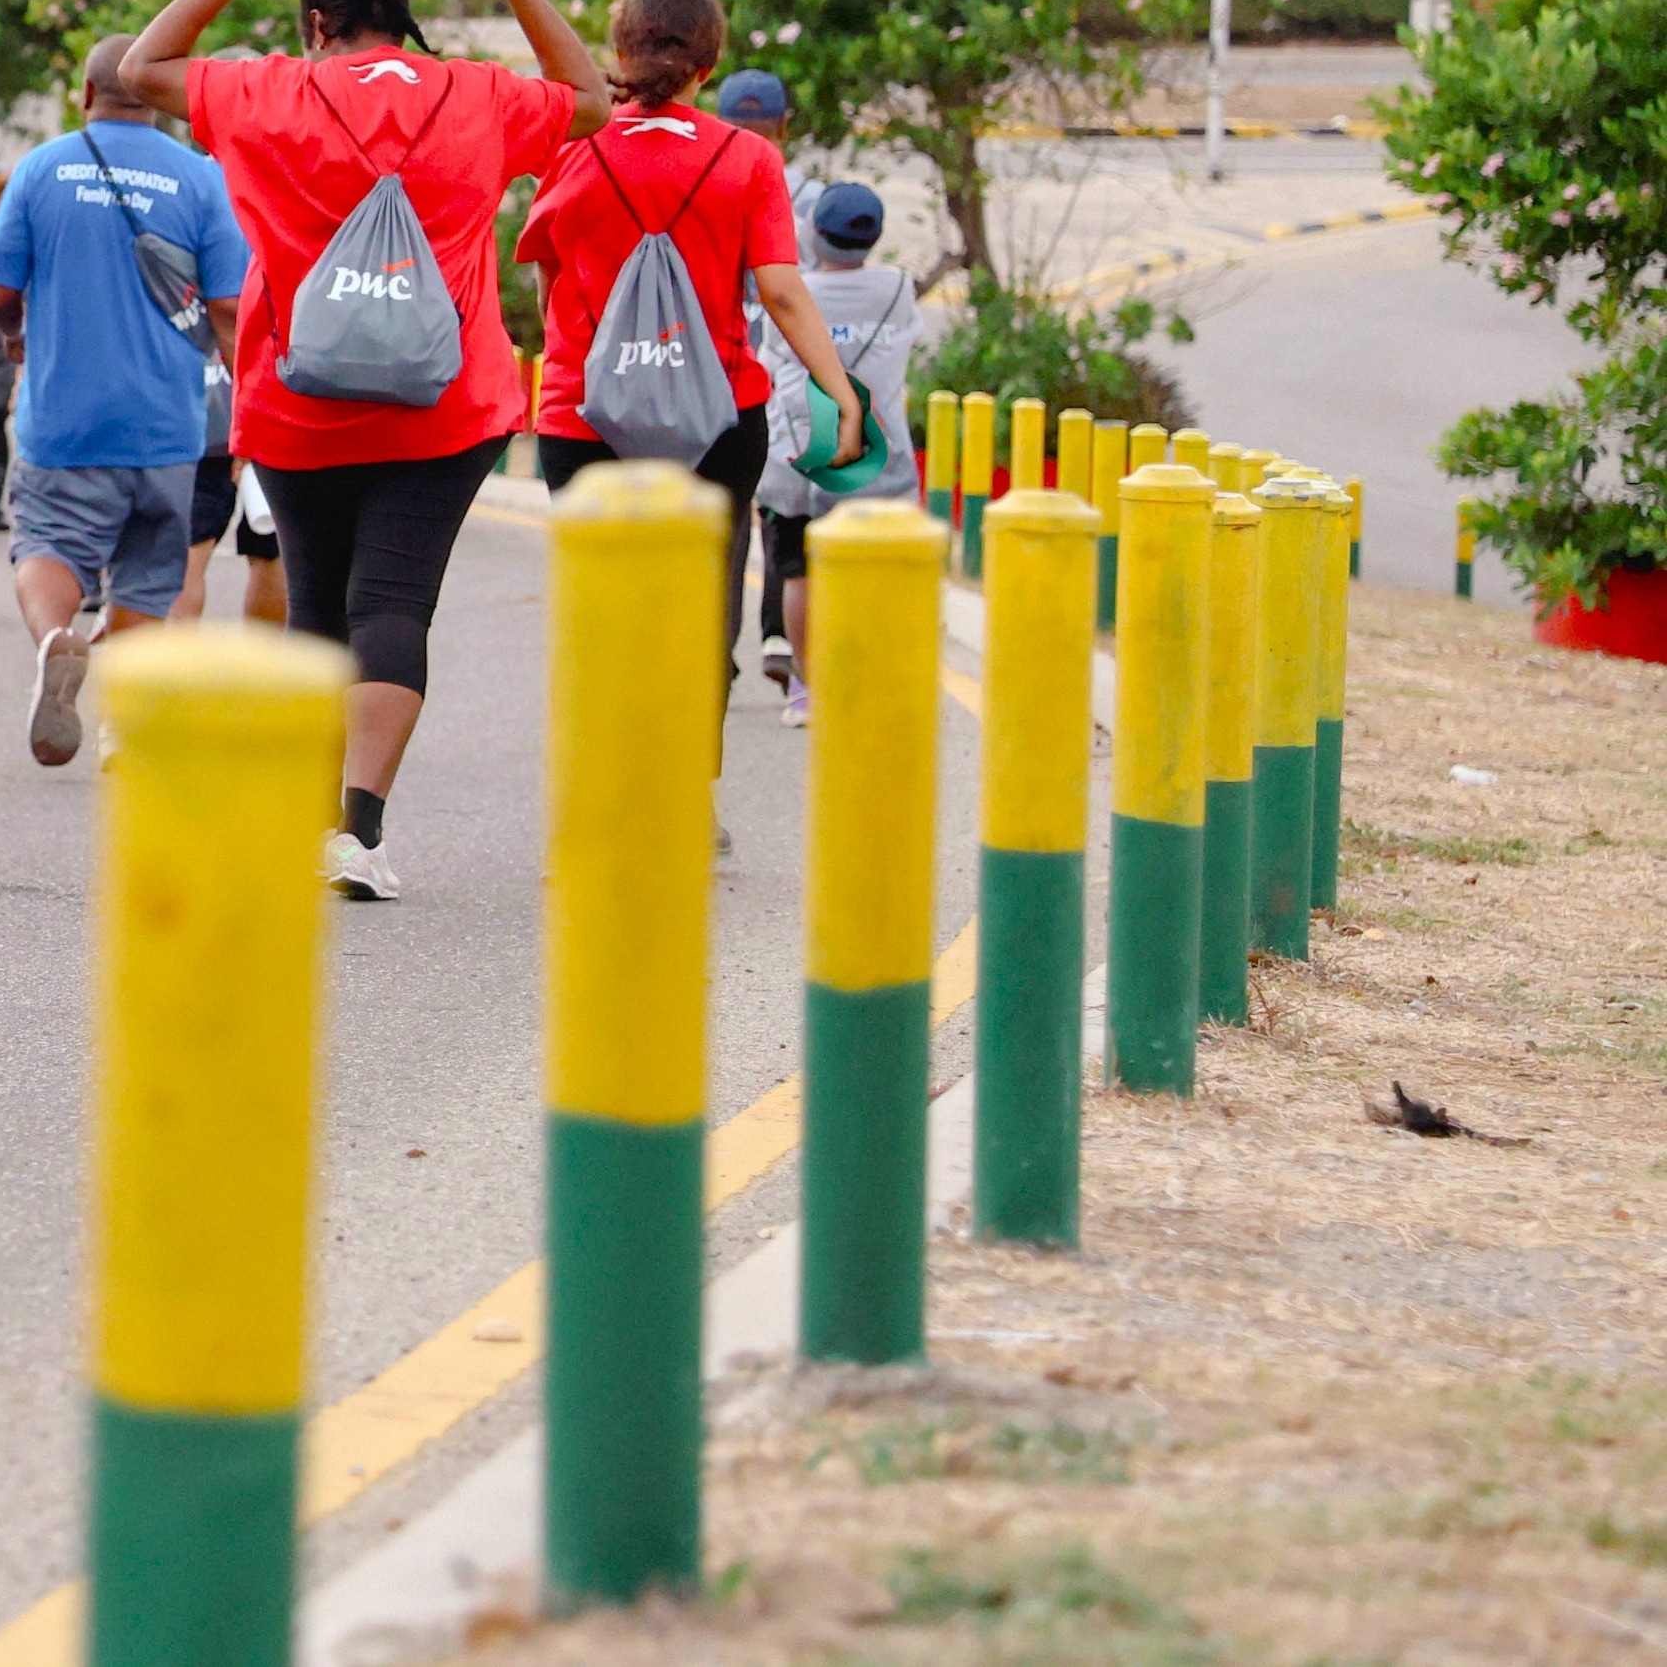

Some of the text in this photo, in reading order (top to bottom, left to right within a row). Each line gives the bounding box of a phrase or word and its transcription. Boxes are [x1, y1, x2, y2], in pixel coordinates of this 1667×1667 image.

[56, 163, 99, 182] CREDIT
[75, 184, 112, 208] Family
[130, 191, 154, 215] Day
[326, 266, 412, 302] pwc
[612, 338, 685, 375] pwc
